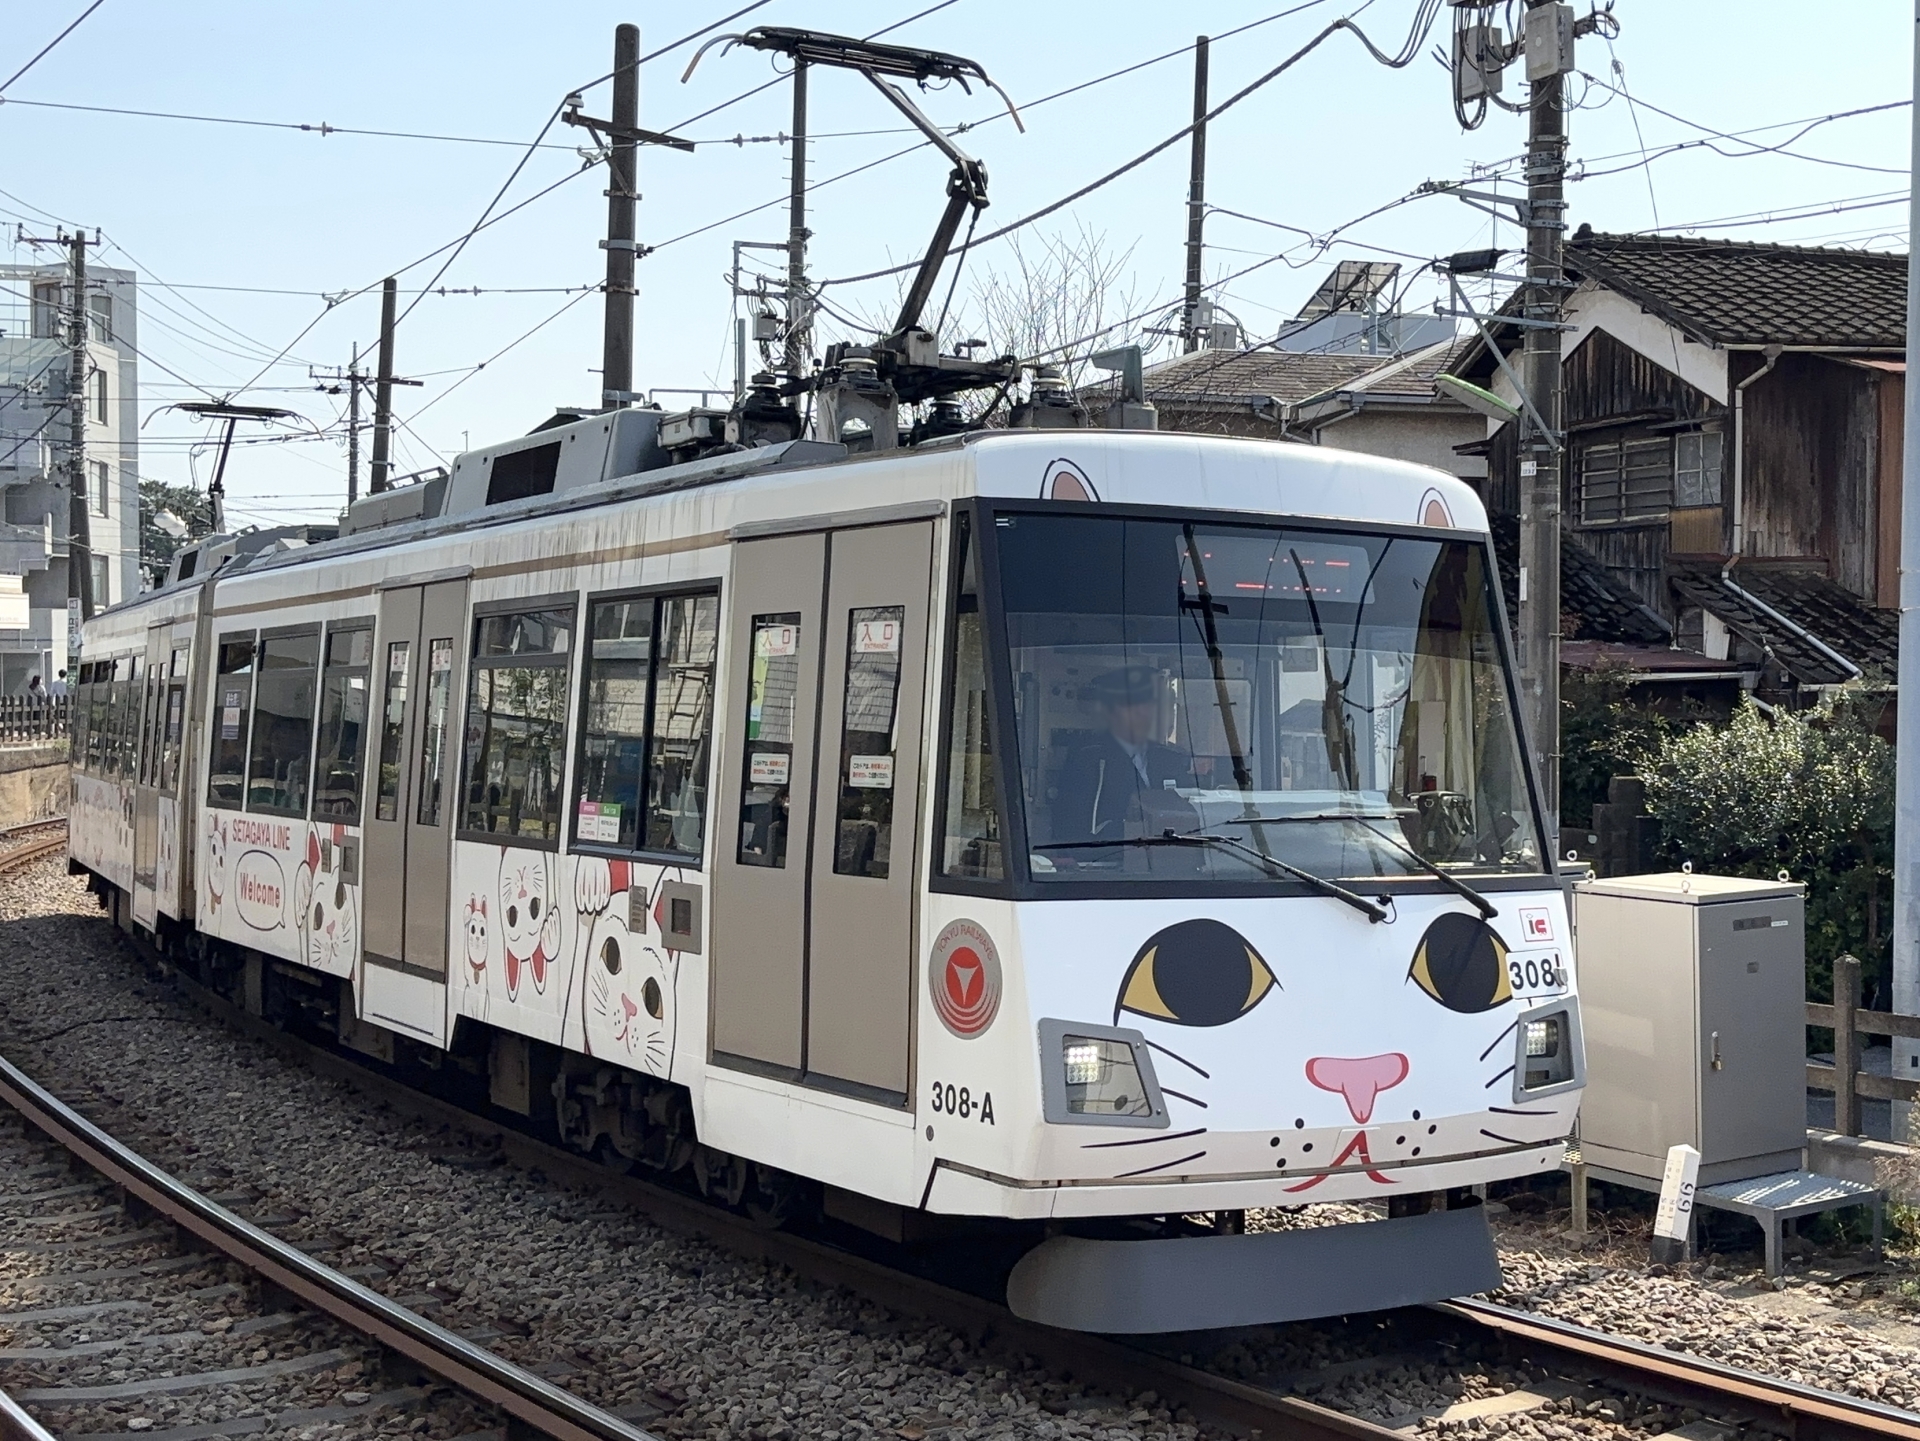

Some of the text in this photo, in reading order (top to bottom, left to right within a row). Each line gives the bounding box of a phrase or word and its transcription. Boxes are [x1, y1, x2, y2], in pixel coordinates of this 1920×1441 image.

[861, 623, 894, 642] 入口
[232, 818, 290, 850] SETAGAYA LINE
[239, 872, 281, 908] Welcome
[937, 925, 959, 953] TOKYU
[1509, 958, 1556, 990] 308
[931, 1081, 996, 1126] 308-A
